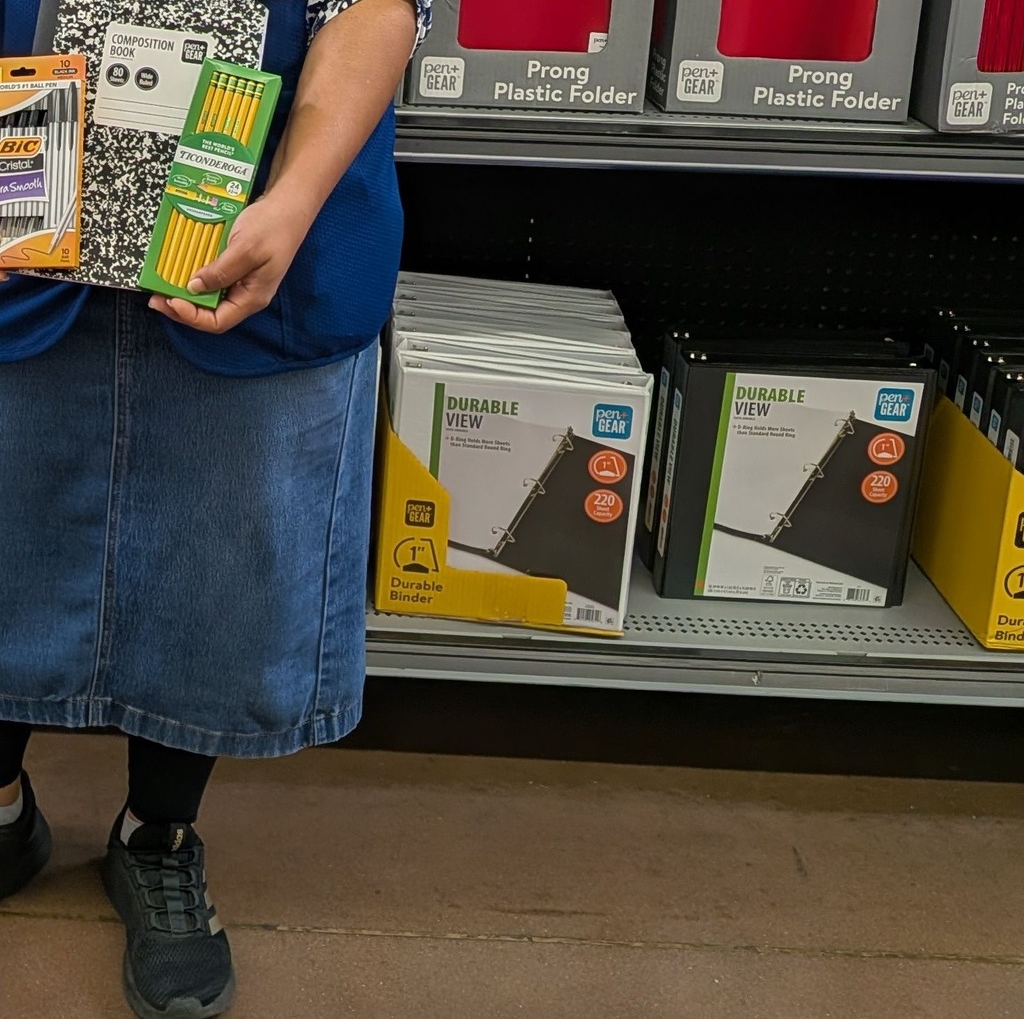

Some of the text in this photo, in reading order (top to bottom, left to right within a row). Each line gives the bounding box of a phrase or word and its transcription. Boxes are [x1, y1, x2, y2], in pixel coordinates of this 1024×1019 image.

[111, 33, 175, 52] COMPOSITION
[110, 45, 136, 58] BOOK
[112, 67, 124, 77] 80
[527, 60, 590, 84] Prong
[426, 75, 457, 91] GEAR
[494, 83, 637, 105] Plastic Folder
[179, 150, 248, 176] TICONDEROGA
[736, 386, 805, 404] DURABLE
[447, 397, 519, 415] DURABLE
[734, 401, 771, 417] VIEW
[445, 413, 483, 429] VIEW
[391, 578, 443, 593] Durable
[390, 591, 433, 604] Binder
